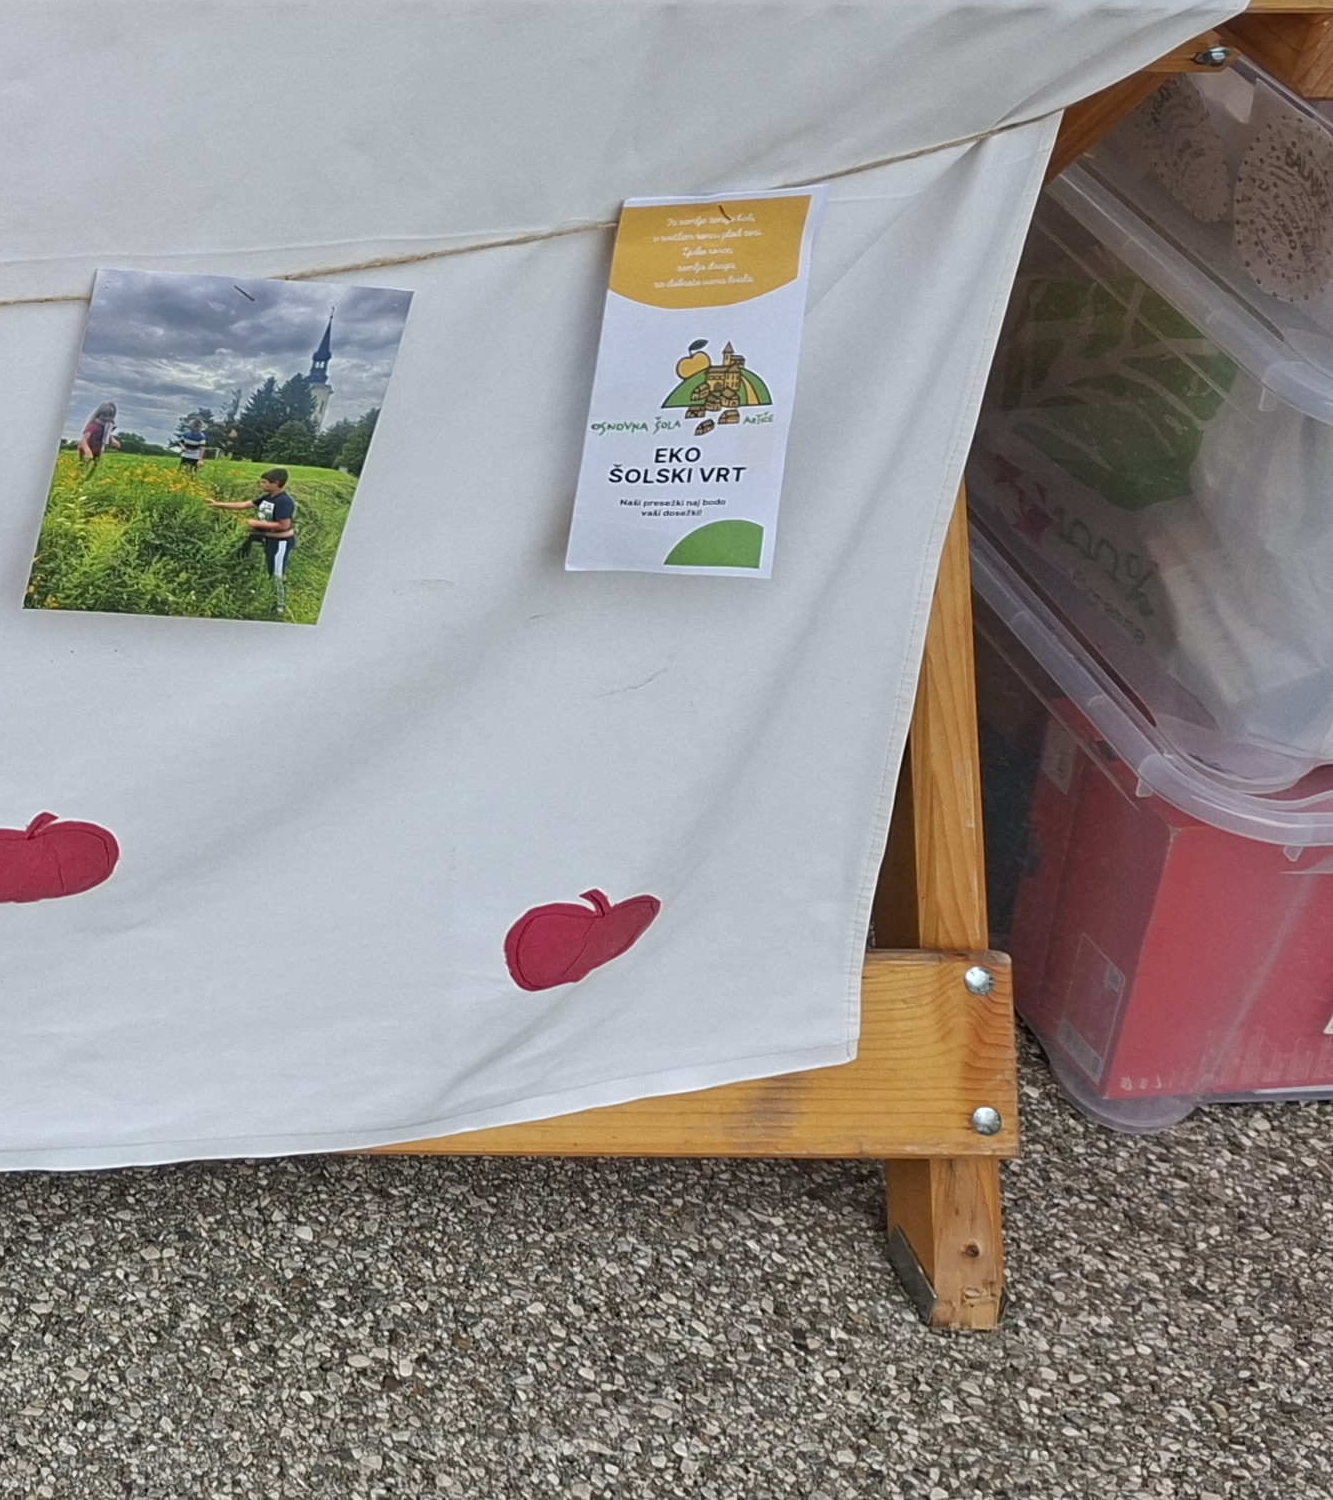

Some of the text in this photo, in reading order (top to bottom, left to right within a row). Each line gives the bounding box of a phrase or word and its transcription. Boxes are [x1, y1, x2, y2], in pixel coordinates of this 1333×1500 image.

[591, 421, 648, 436] OSNOVNA
[653, 416, 681, 435] ŠOLA
[654, 447, 701, 463] EKO
[608, 464, 747, 484] ŠOLSKI VRT
[620, 499, 641, 507] Naši
[643, 499, 685, 508] presežki
[686, 498, 700, 507] naj
